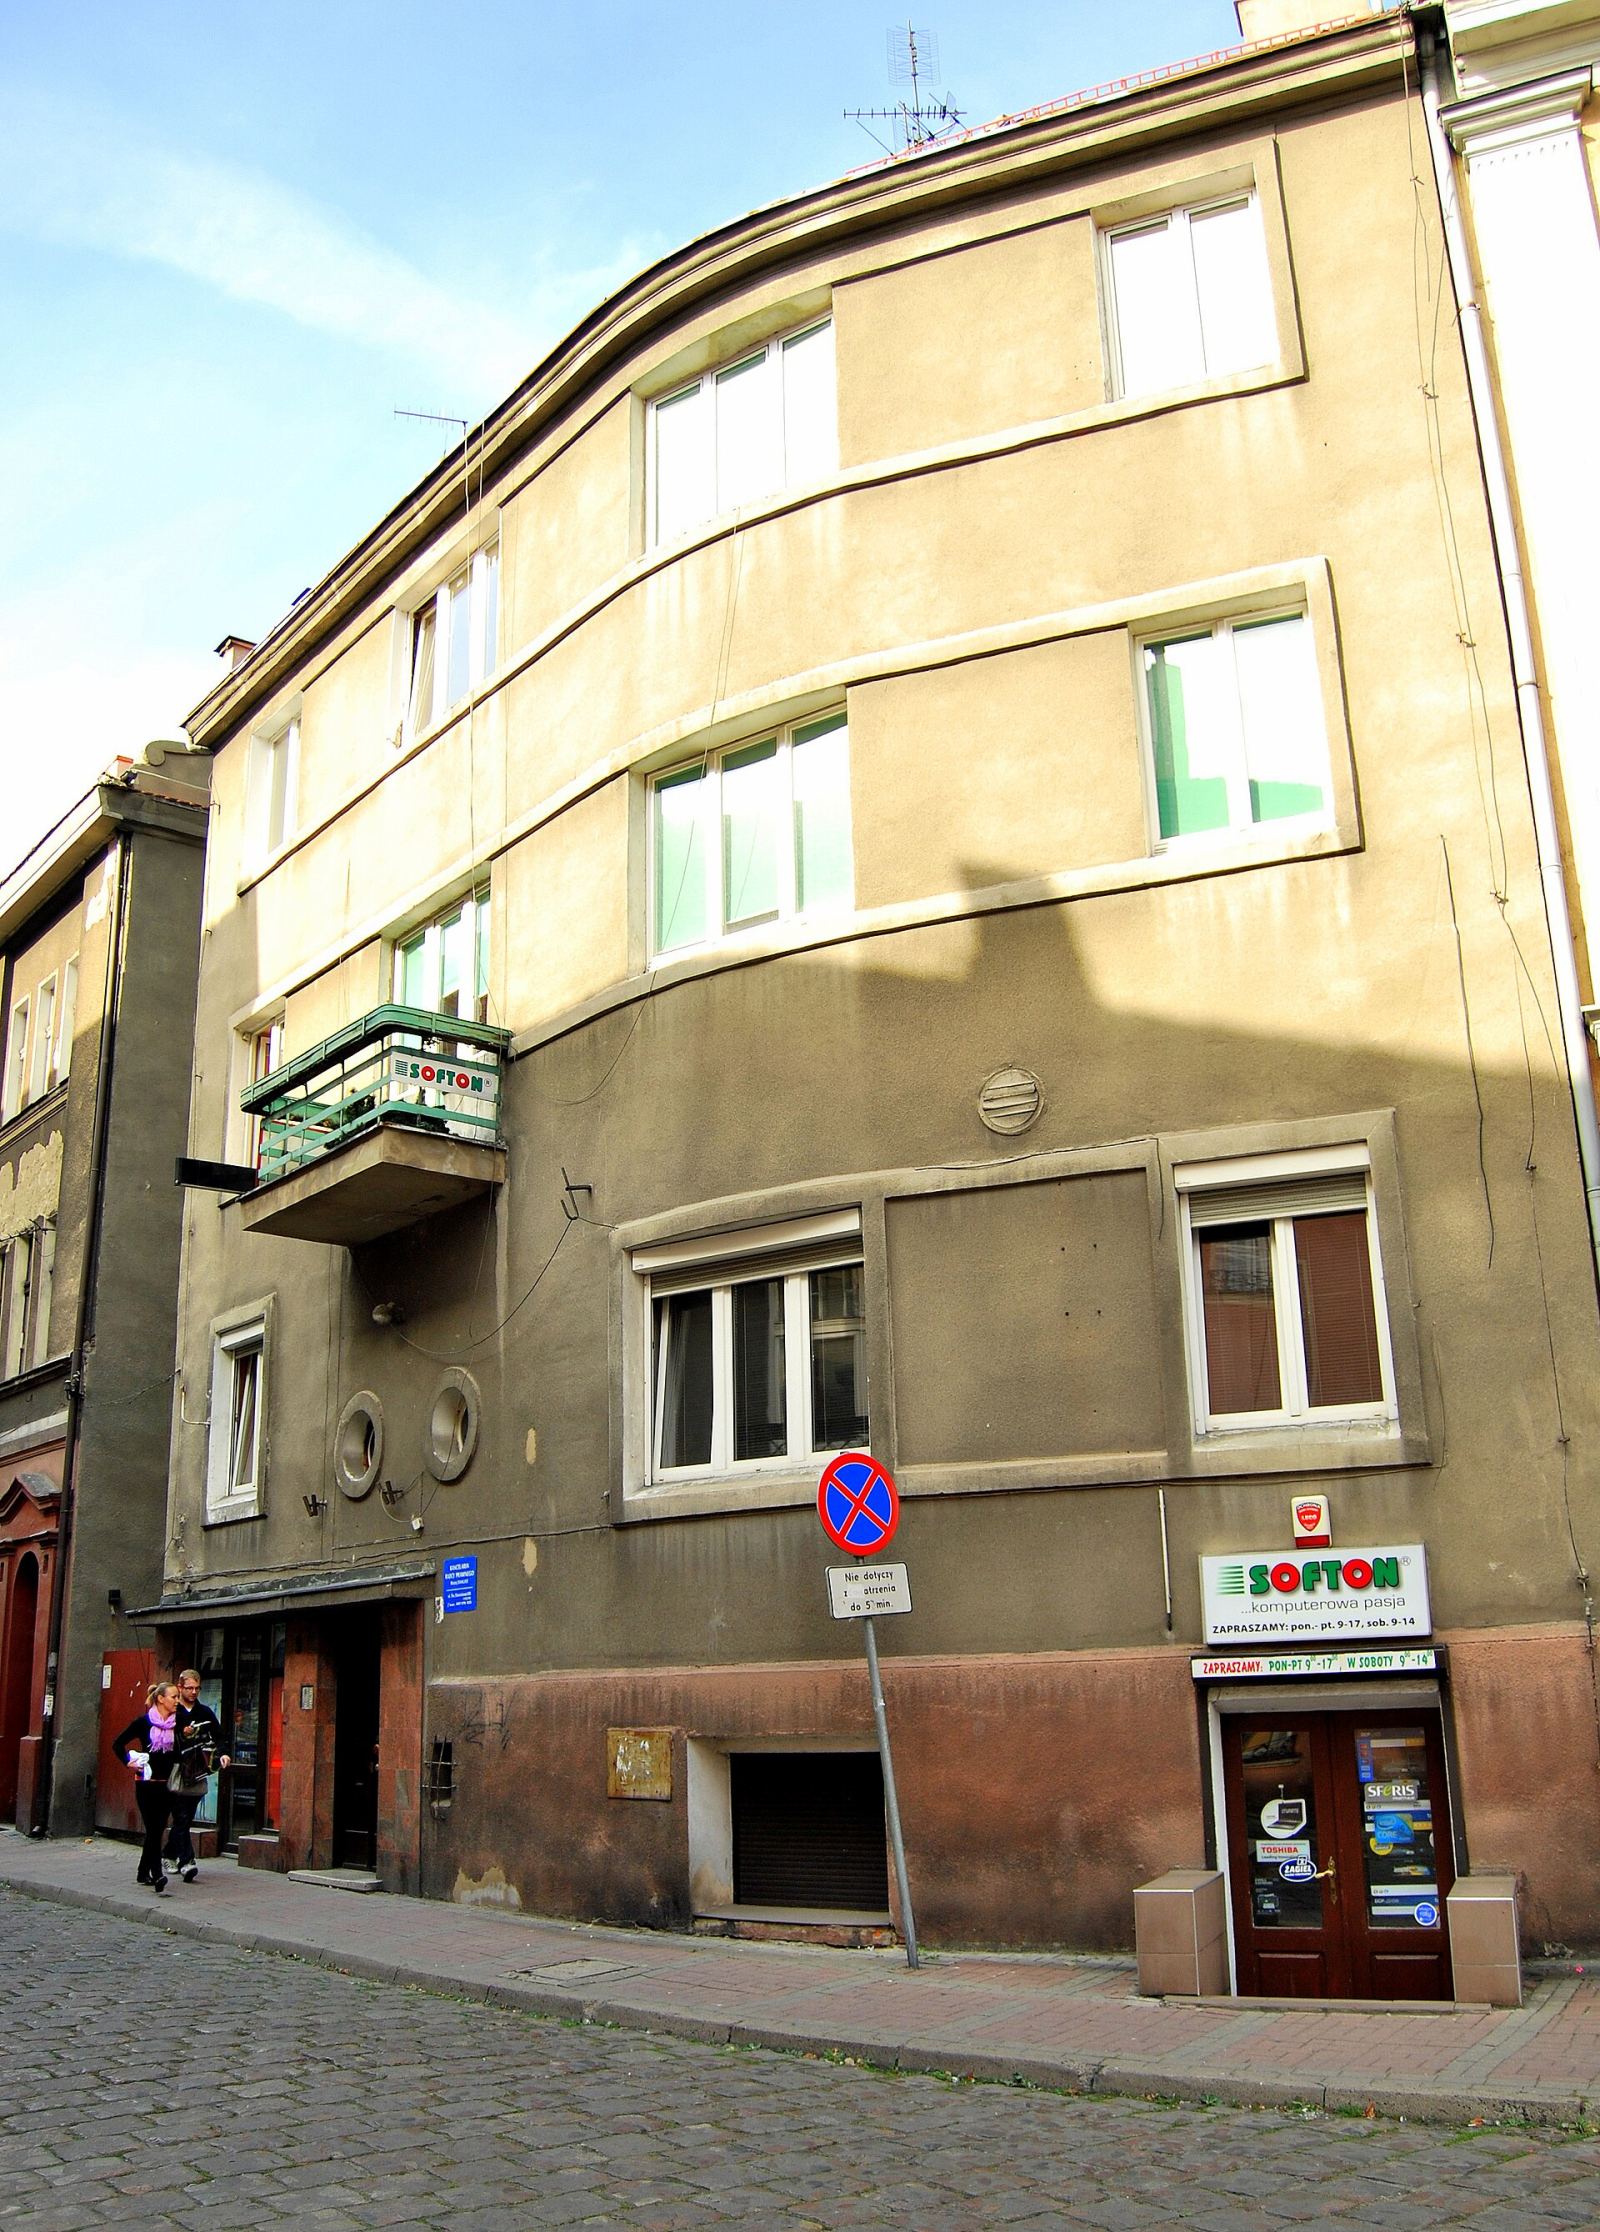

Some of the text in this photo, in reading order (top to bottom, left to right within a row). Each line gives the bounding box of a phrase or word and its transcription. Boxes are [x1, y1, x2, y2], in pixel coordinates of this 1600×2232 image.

[409, 1063, 483, 1092] SOFTON
[844, 1571, 893, 1582] Nie dotyczy
[1249, 1557, 1399, 1594] SOFTON
[850, 1602, 861, 1611] do
[865, 1600, 871, 1610] 5
[1364, 1594, 1406, 1611] pasja
[1212, 1623, 1289, 1634] ZAPRASZAMY:
[1321, 1621, 1335, 1631] pt.
[1367, 1618, 1389, 1628] sob.
[1391, 1617, 1416, 1626] 9-14
[1203, 1661, 1263, 1674] ZAPRASZAMY:
[1268, 1659, 1302, 1671] PON-PT
[1347, 1656, 1356, 1668] W
[1359, 1655, 1393, 1668] SOBOTY
[1261, 1846, 1299, 1854] TOSHIBA
